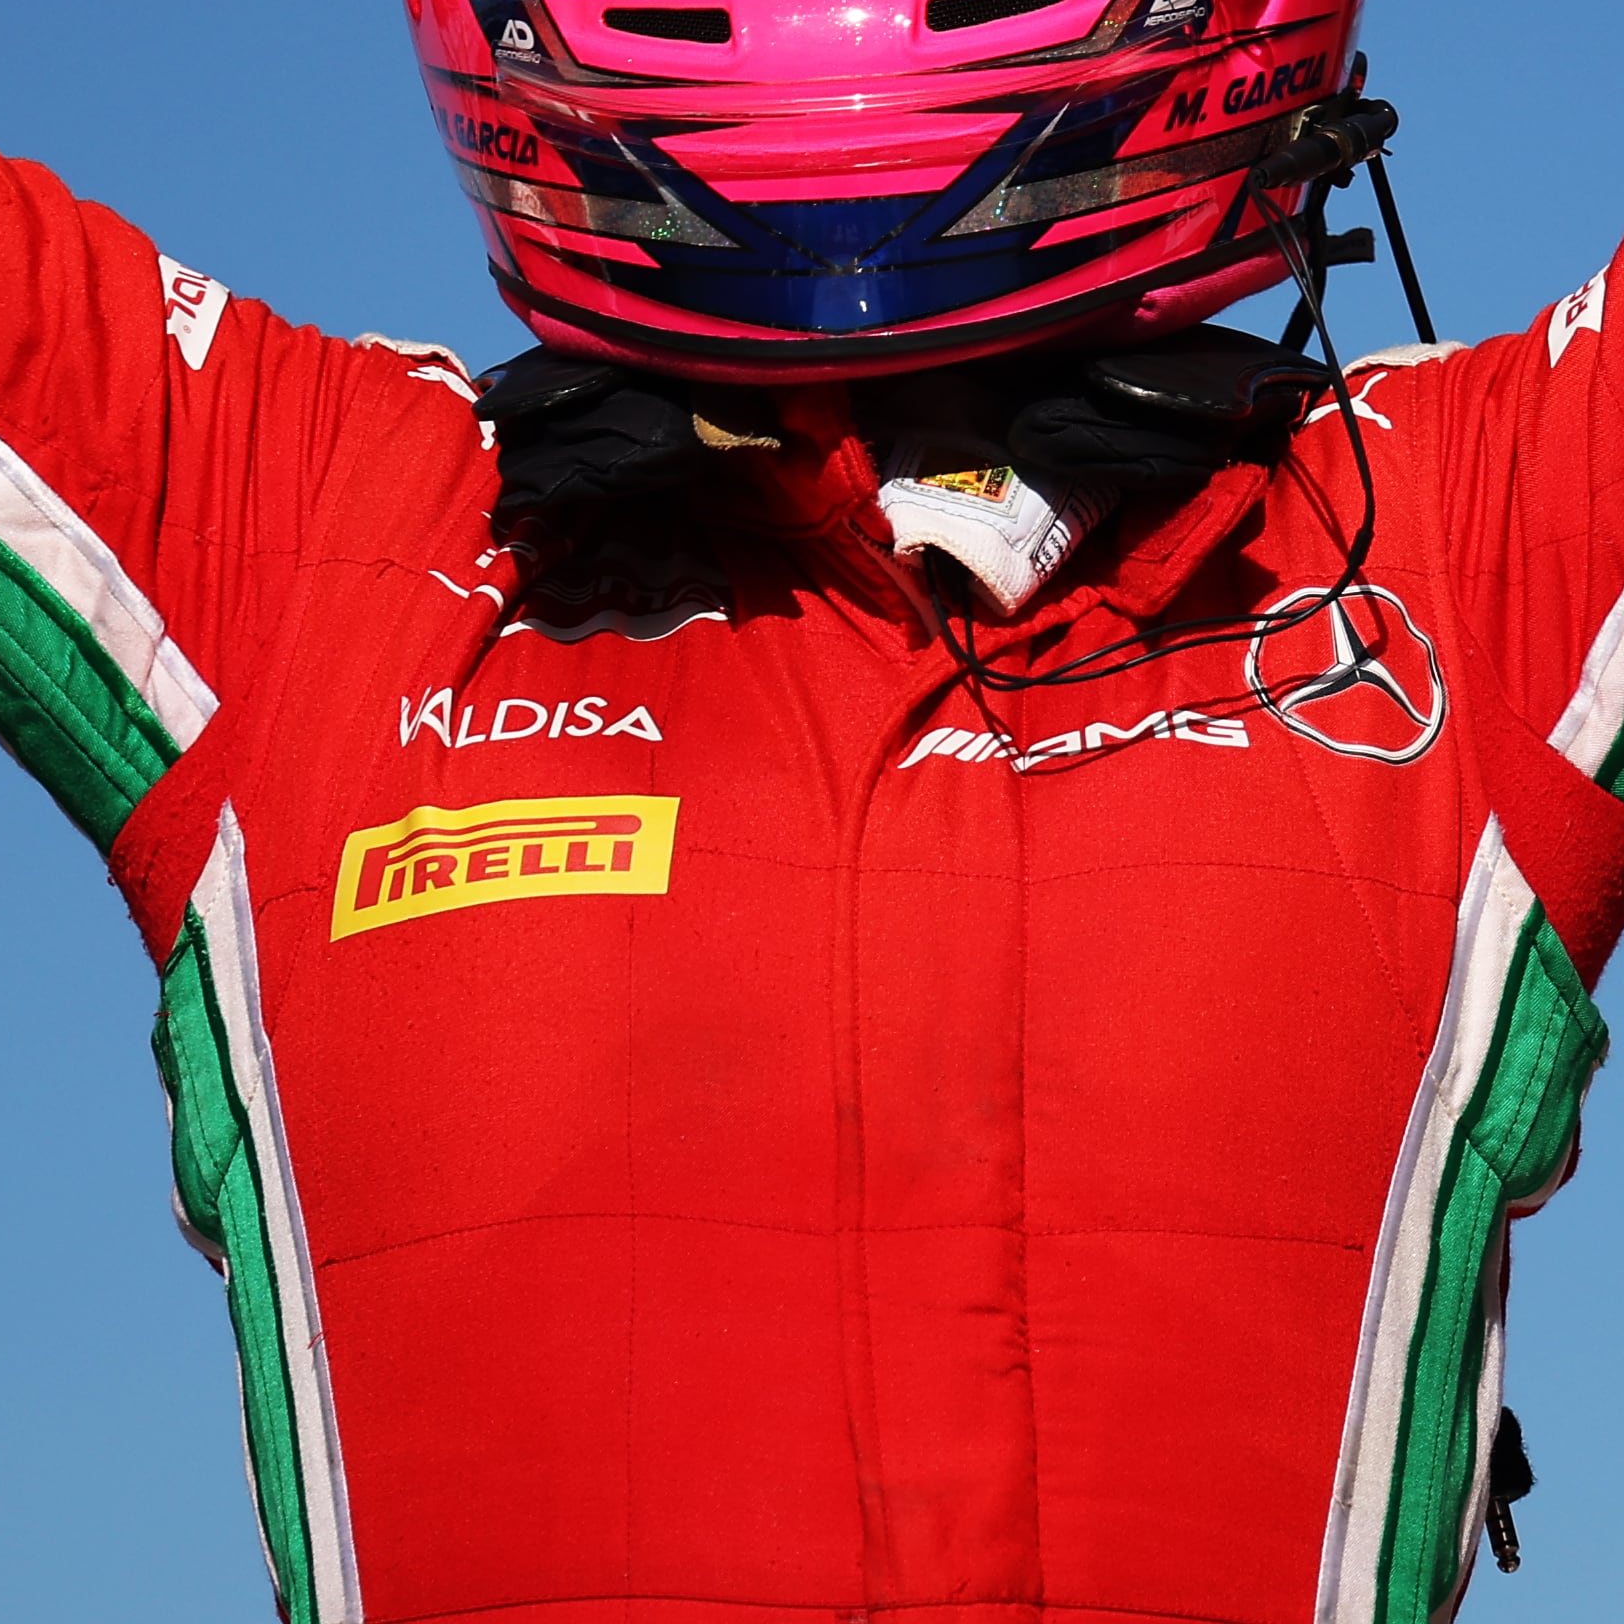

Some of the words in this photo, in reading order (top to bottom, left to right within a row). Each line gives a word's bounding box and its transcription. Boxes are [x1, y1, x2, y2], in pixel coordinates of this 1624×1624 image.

[1162, 86, 1210, 132] M.
[1223, 51, 1327, 114] GARCIA
[453, 111, 540, 167] GARCIA
[399, 685, 664, 749] VALDISA
[1012, 709, 1250, 773] AMG
[353, 814, 643, 913] PIRELLI
